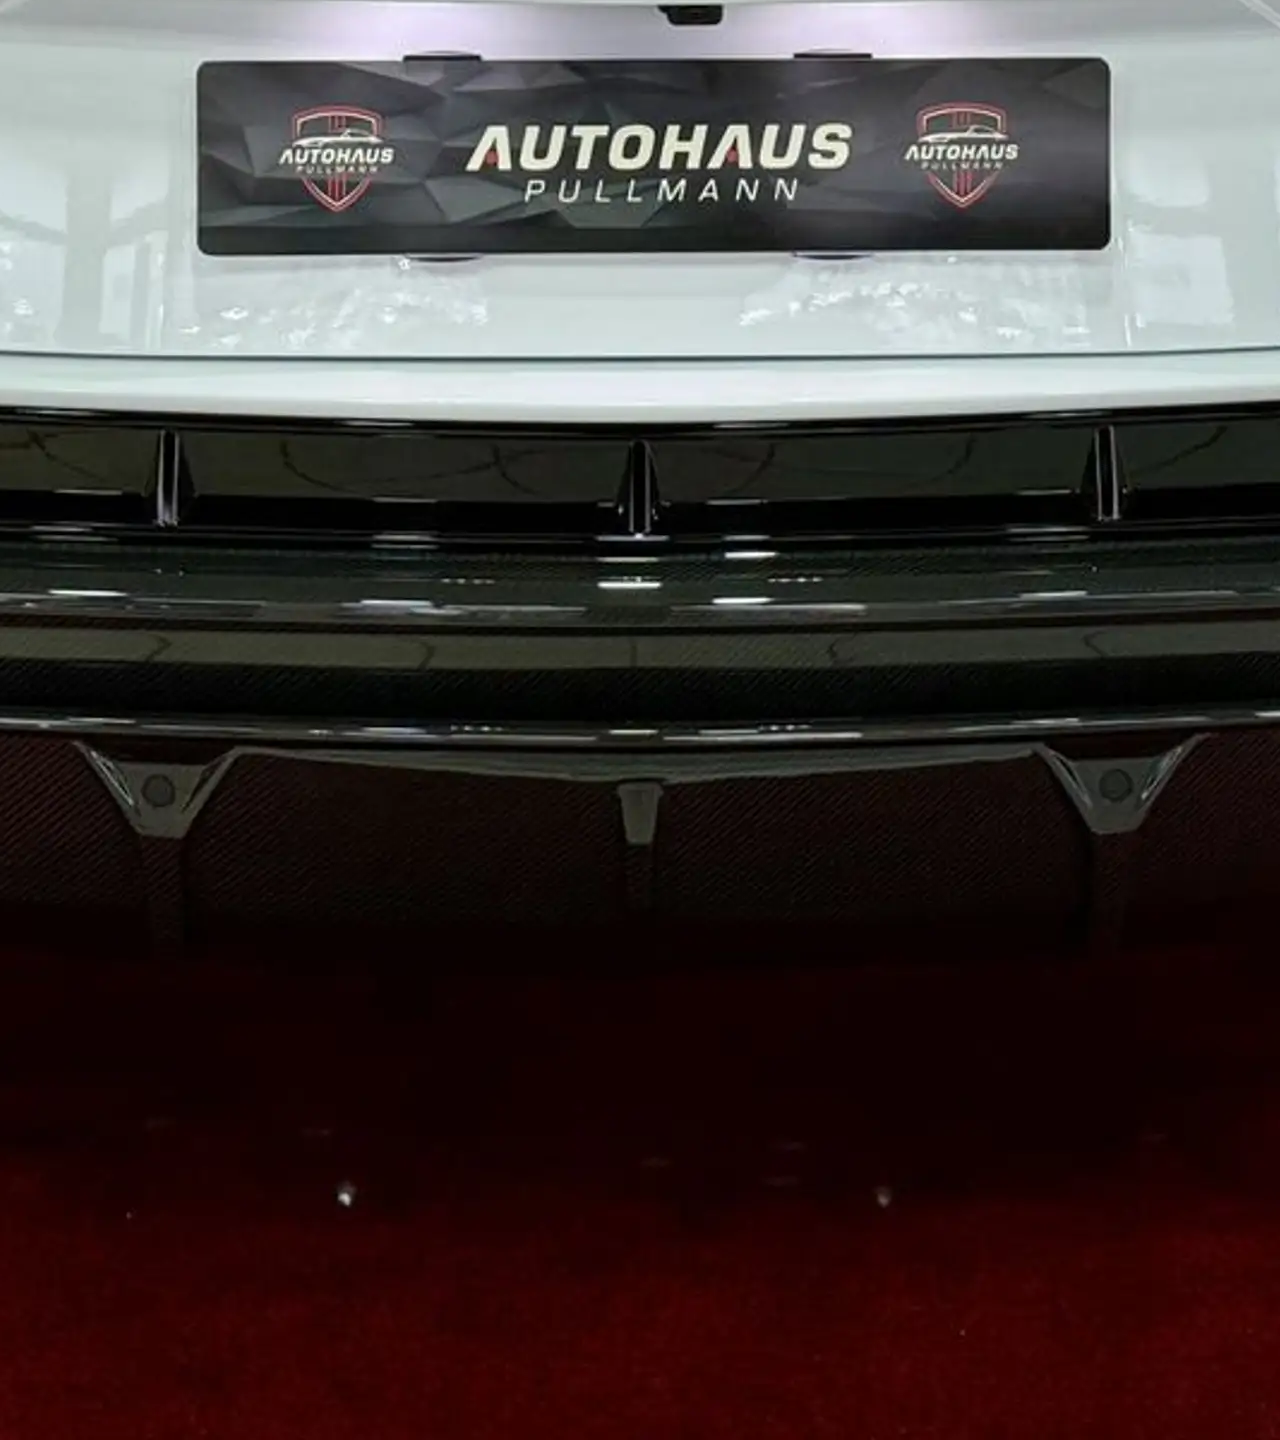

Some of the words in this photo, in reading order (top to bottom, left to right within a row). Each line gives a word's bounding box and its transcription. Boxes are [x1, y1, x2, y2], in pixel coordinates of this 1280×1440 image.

[465, 123, 853, 171] AUTOHAUS
[904, 143, 1019, 160] AUTOHAUS
[278, 147, 395, 165] AUTOHAUS
[295, 165, 379, 175] PULLMANN
[920, 161, 1004, 171] PULLMANN
[524, 178, 799, 203] PULLMANN
